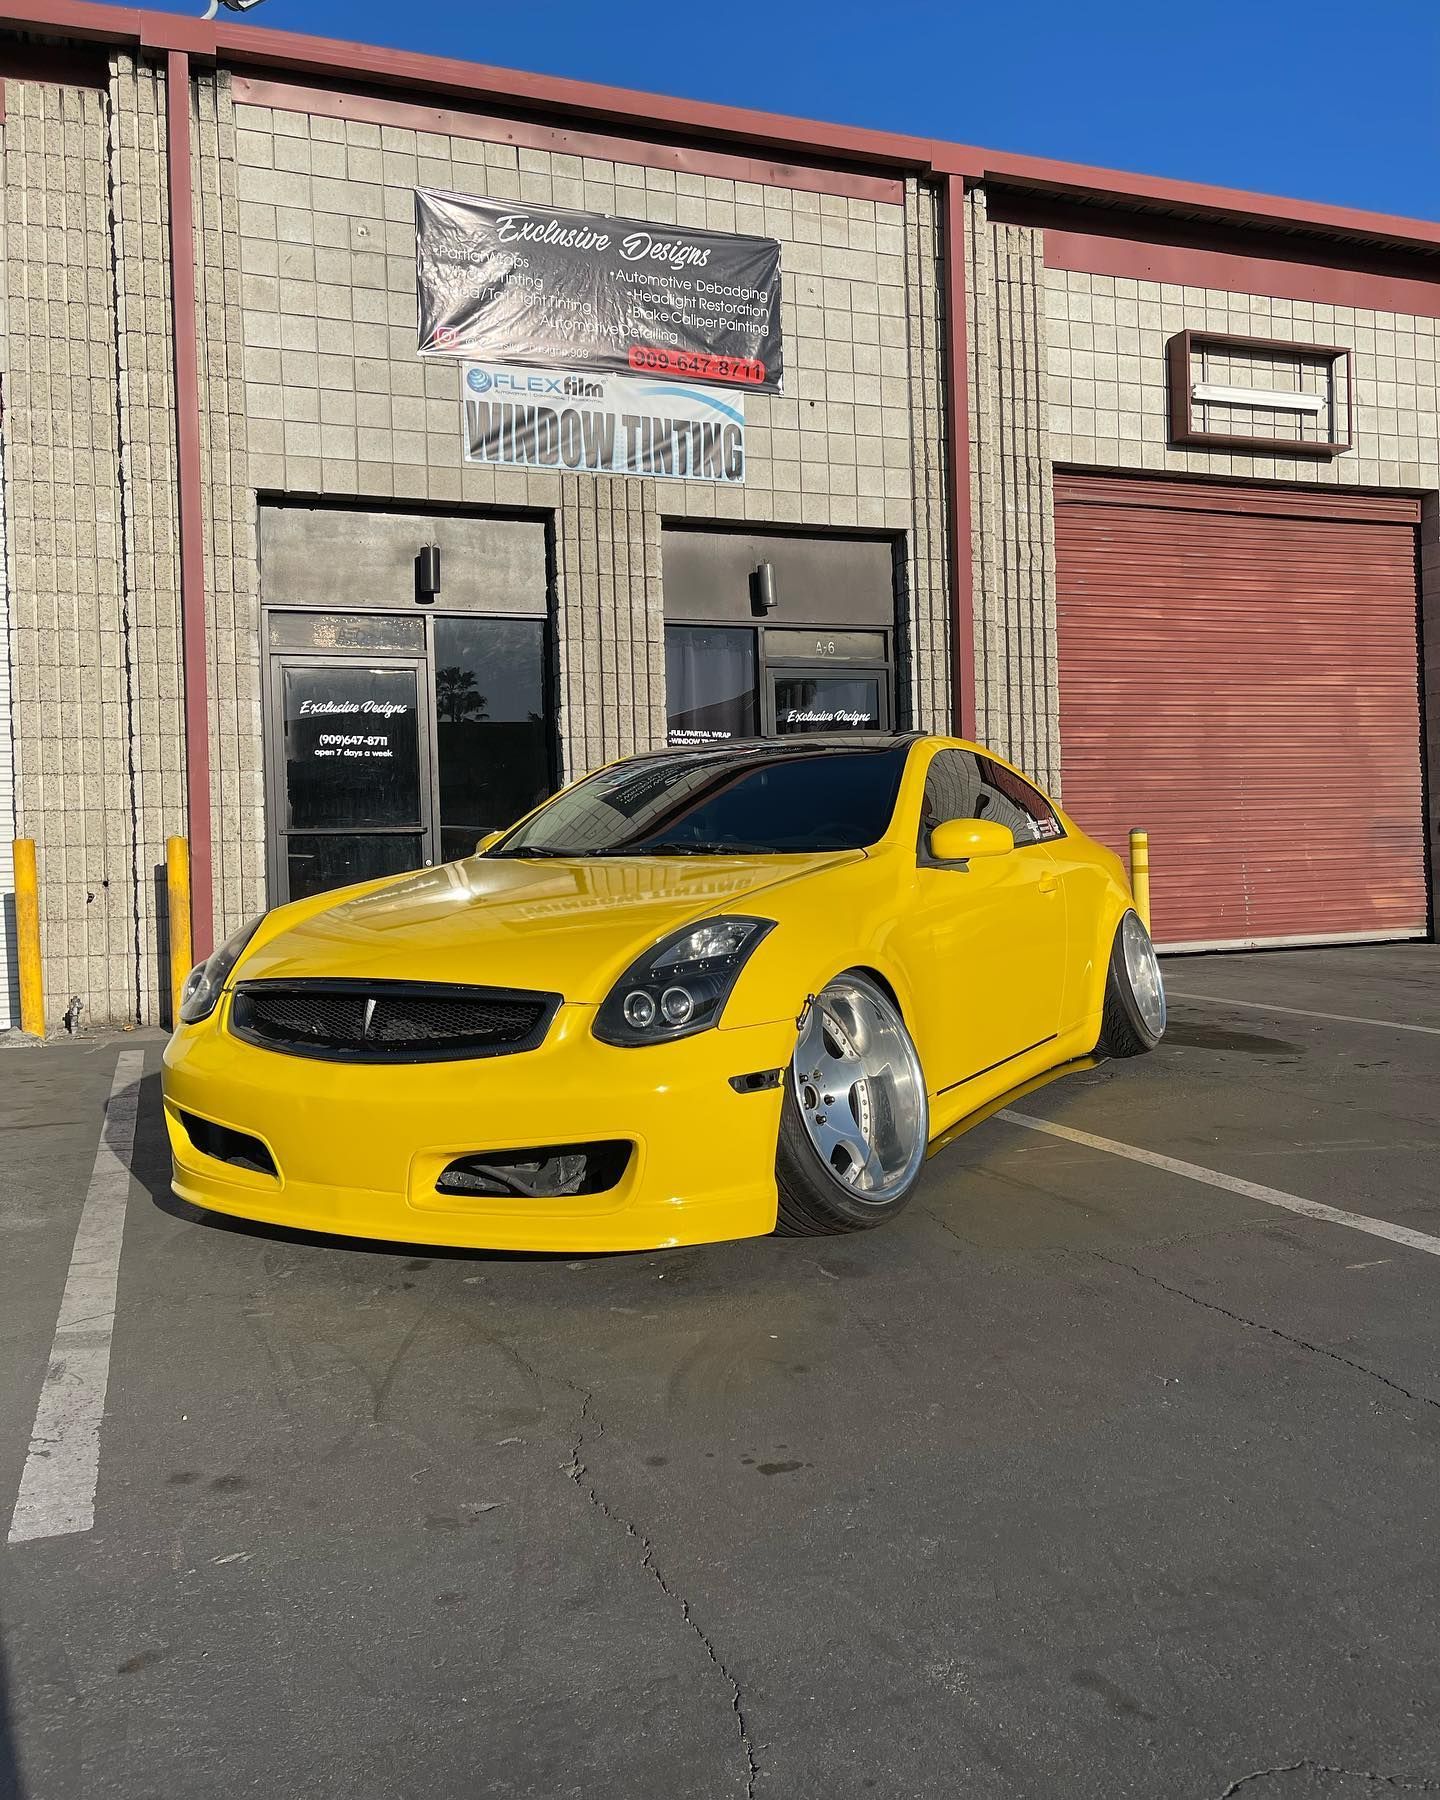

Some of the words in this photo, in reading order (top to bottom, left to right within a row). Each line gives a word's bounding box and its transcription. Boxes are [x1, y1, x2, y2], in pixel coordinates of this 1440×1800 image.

[495, 214, 611, 251] Exclusive
[619, 232, 711, 270] Designs
[500, 271, 544, 289] Tinting
[615, 269, 692, 290] Automotive
[696, 280, 768, 303] Debadging
[548, 294, 592, 314] Tinting
[633, 288, 697, 309] Headlight
[699, 298, 769, 318] Restoration
[540, 315, 618, 335] Automotive
[619, 323, 678, 344] Detailing
[632, 306, 669, 323] Brake
[671, 311, 718, 330] Caliper
[719, 318, 769, 337] Painting
[633, 350, 761, 380] 909-647-8711
[465, 400, 616, 470] WINDOW
[622, 415, 742, 482] TINTING
[300, 700, 359, 715] Exclusive
[360, 700, 408, 718] Designs
[787, 710, 833, 723] Exclusive
[834, 710, 871, 725] Designs
[314, 749, 335, 757] open
[336, 748, 342, 756] 7
[343, 749, 363, 757] days
[372, 749, 393, 757] week
[319, 734, 388, 747] (909)647-8711
